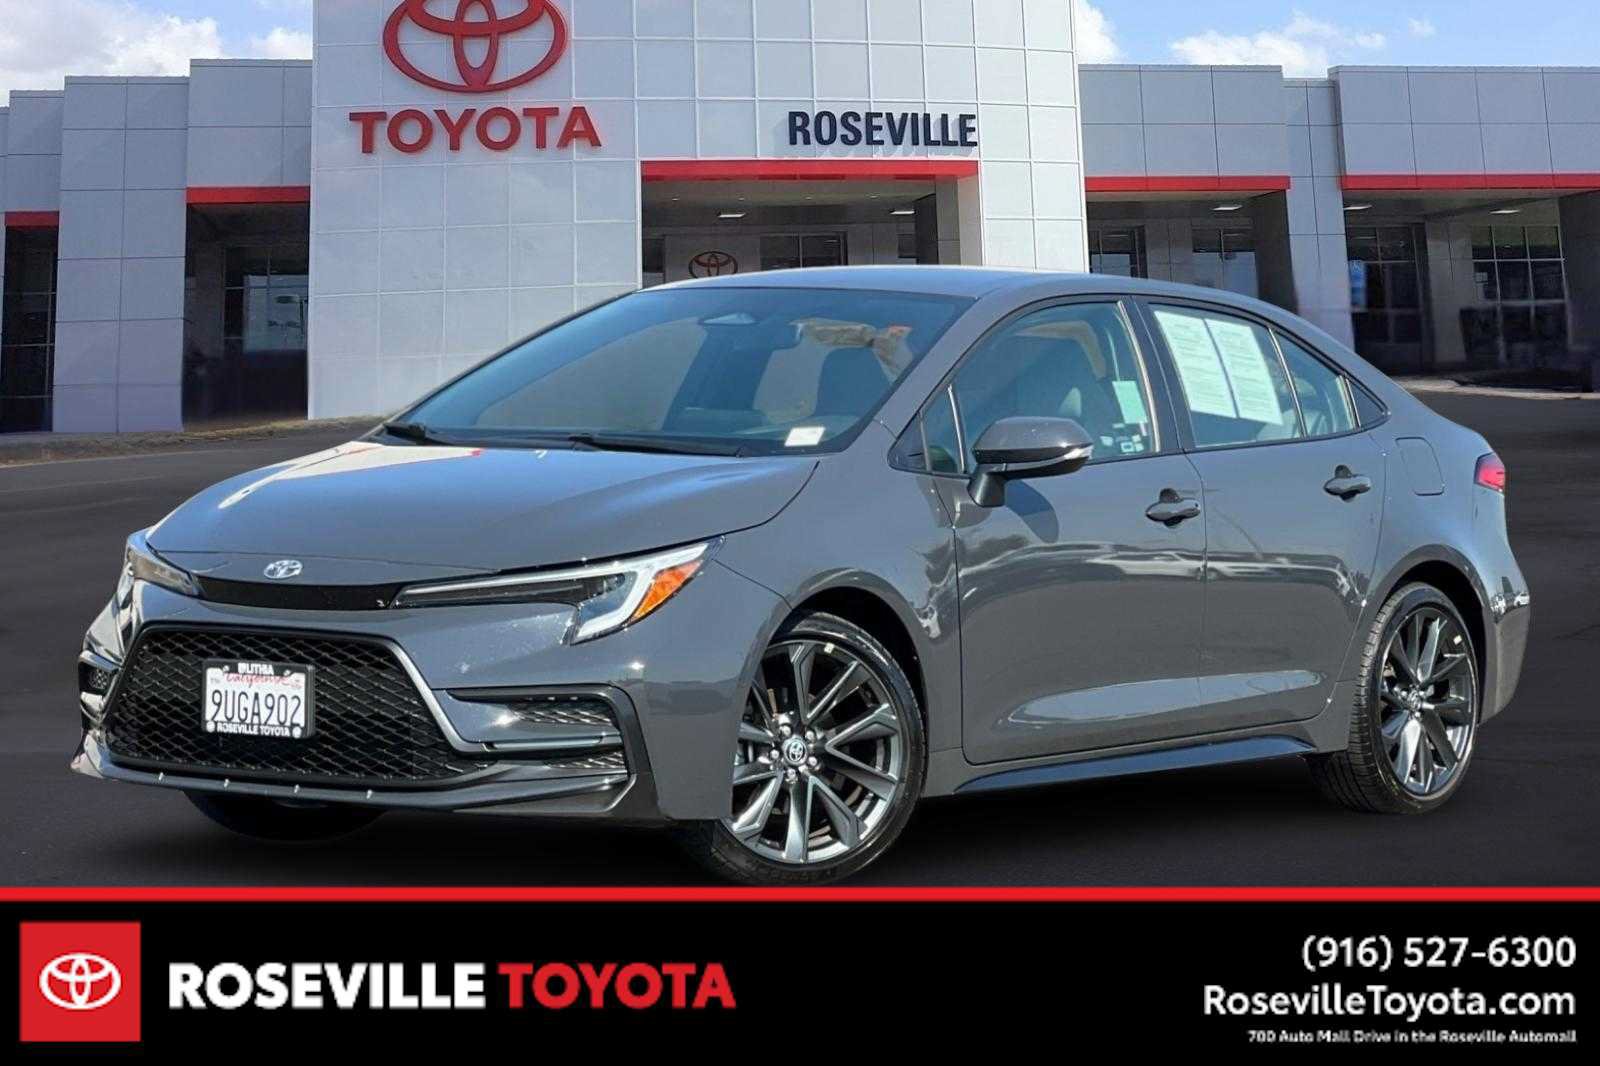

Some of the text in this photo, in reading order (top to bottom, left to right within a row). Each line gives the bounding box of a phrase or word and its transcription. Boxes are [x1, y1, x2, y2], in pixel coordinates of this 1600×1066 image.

[349, 106, 602, 154] TOYOTA
[789, 111, 978, 148] ROSEVILLE
[211, 689, 302, 727] 9UGA902
[217, 722, 291, 737] ROSEVILLE TOYOTA
